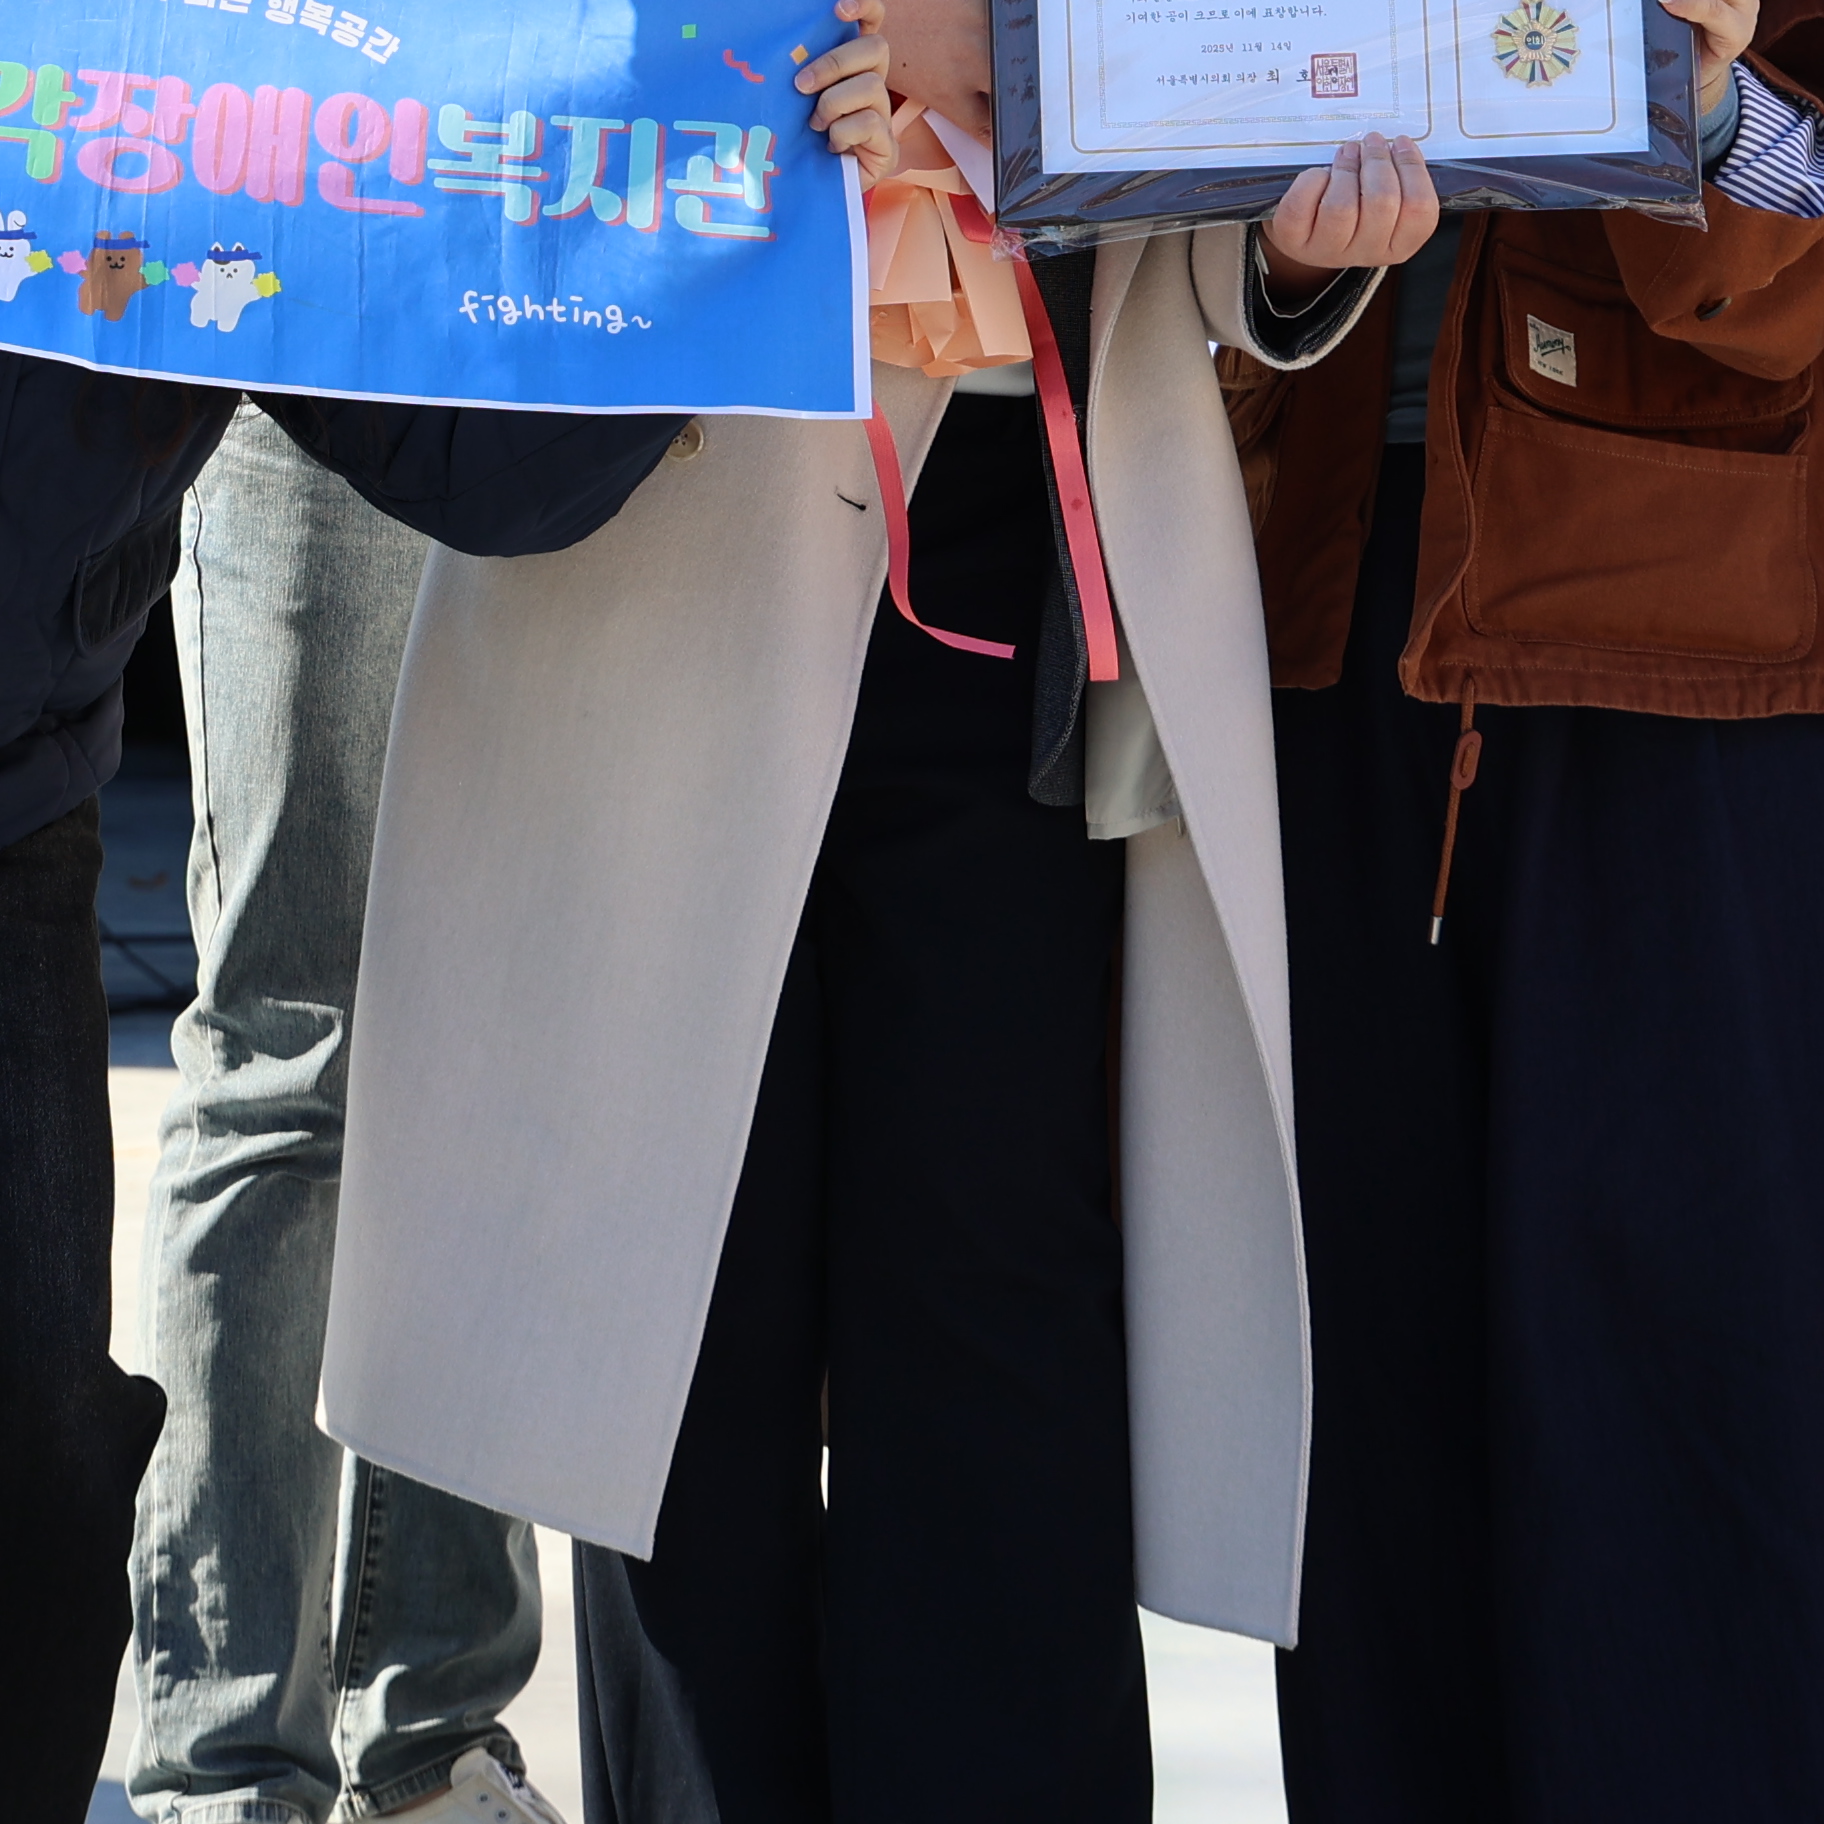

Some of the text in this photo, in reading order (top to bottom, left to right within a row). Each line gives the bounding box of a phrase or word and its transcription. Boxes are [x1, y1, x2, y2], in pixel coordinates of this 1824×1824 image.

[1126, 5, 1327, 23] 기여한 공이 크므로 이에 표창합니다.
[1201, 41, 1292, 54] 2025년 11월 14일
[1156, 72, 1231, 86] 서울특별시의회
[1236, 71, 1257, 84] 의장
[1267, 68, 1280, 84] 최
[1296, 69, 1311, 83] 호
